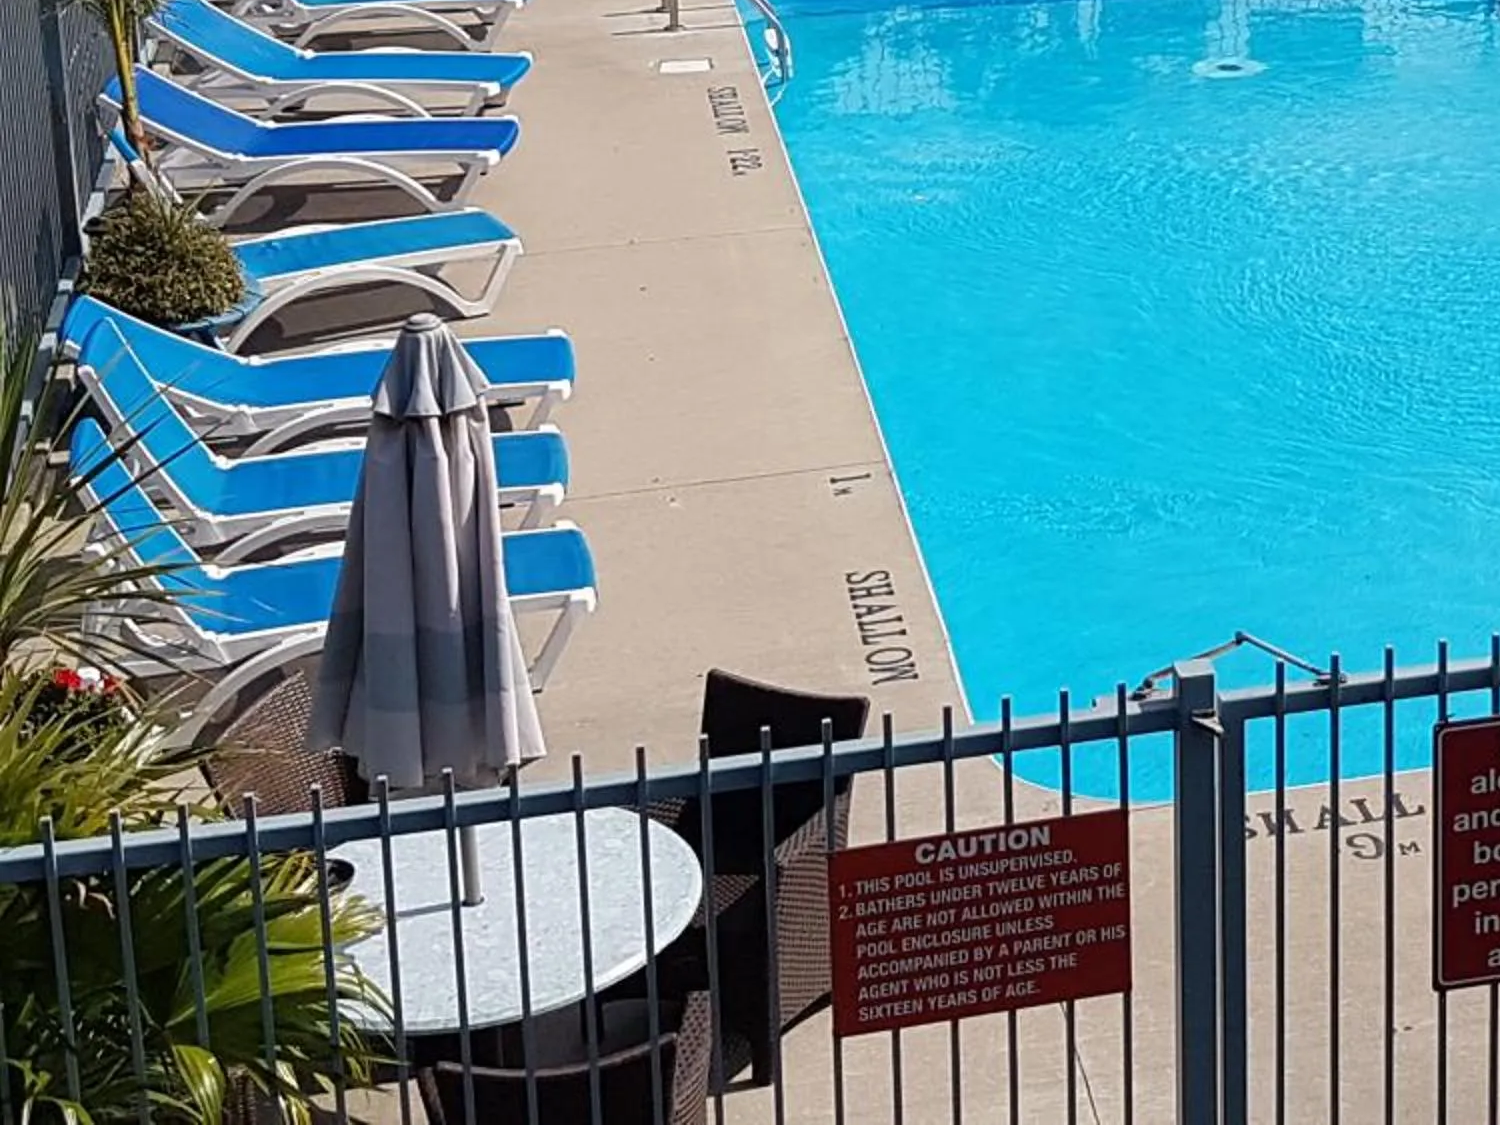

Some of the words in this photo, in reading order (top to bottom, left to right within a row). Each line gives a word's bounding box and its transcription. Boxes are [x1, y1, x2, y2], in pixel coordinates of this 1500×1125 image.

[845, 570, 919, 685] SHALLOW
[915, 826, 1050, 864] CAUTION
[839, 885, 852, 899] 1.
[856, 878, 890, 896] THIS
[894, 872, 934, 890] POOL
[939, 868, 954, 882] IS
[958, 850, 1077, 880] UNSUPERVISED.
[839, 905, 853, 919] 2.
[856, 895, 926, 917] BATHERS
[930, 885, 982, 905] UNDER
[988, 874, 1044, 896] TWELVE
[1050, 868, 1099, 888] YEARS
[1103, 863, 1122, 878] OF
[856, 923, 887, 938] AGE
[891, 916, 922, 933] ARE
[927, 910, 957, 926] NOT
[961, 898, 1033, 921] ALLOWED
[1039, 888, 1095, 908] WITHIN
[1098, 884, 1125, 899] THE
[1475, 912, 1499, 934] in
[856, 942, 896, 959] POOL
[902, 926, 992, 952] ENCLOSURE
[996, 916, 1054, 936] UNLESS
[858, 949, 969, 980] ACCOMPANIED
[973, 947, 993, 961] BY
[999, 944, 1009, 956] A
[1013, 934, 1073, 955] PARENT
[1076, 930, 1097, 946] OR
[1101, 925, 1125, 940] HIS
[858, 982, 908, 1001] AGENT
[914, 973, 950, 991] WHO
[954, 970, 968, 984] IS
[973, 964, 1004, 982] NOT
[1008, 959, 1044, 976] LESS
[1051, 954, 1077, 968] THE
[858, 999, 923, 1022] SIXTEEN
[927, 990, 977, 1011] YEARS
[982, 987, 1000, 1002] OF
